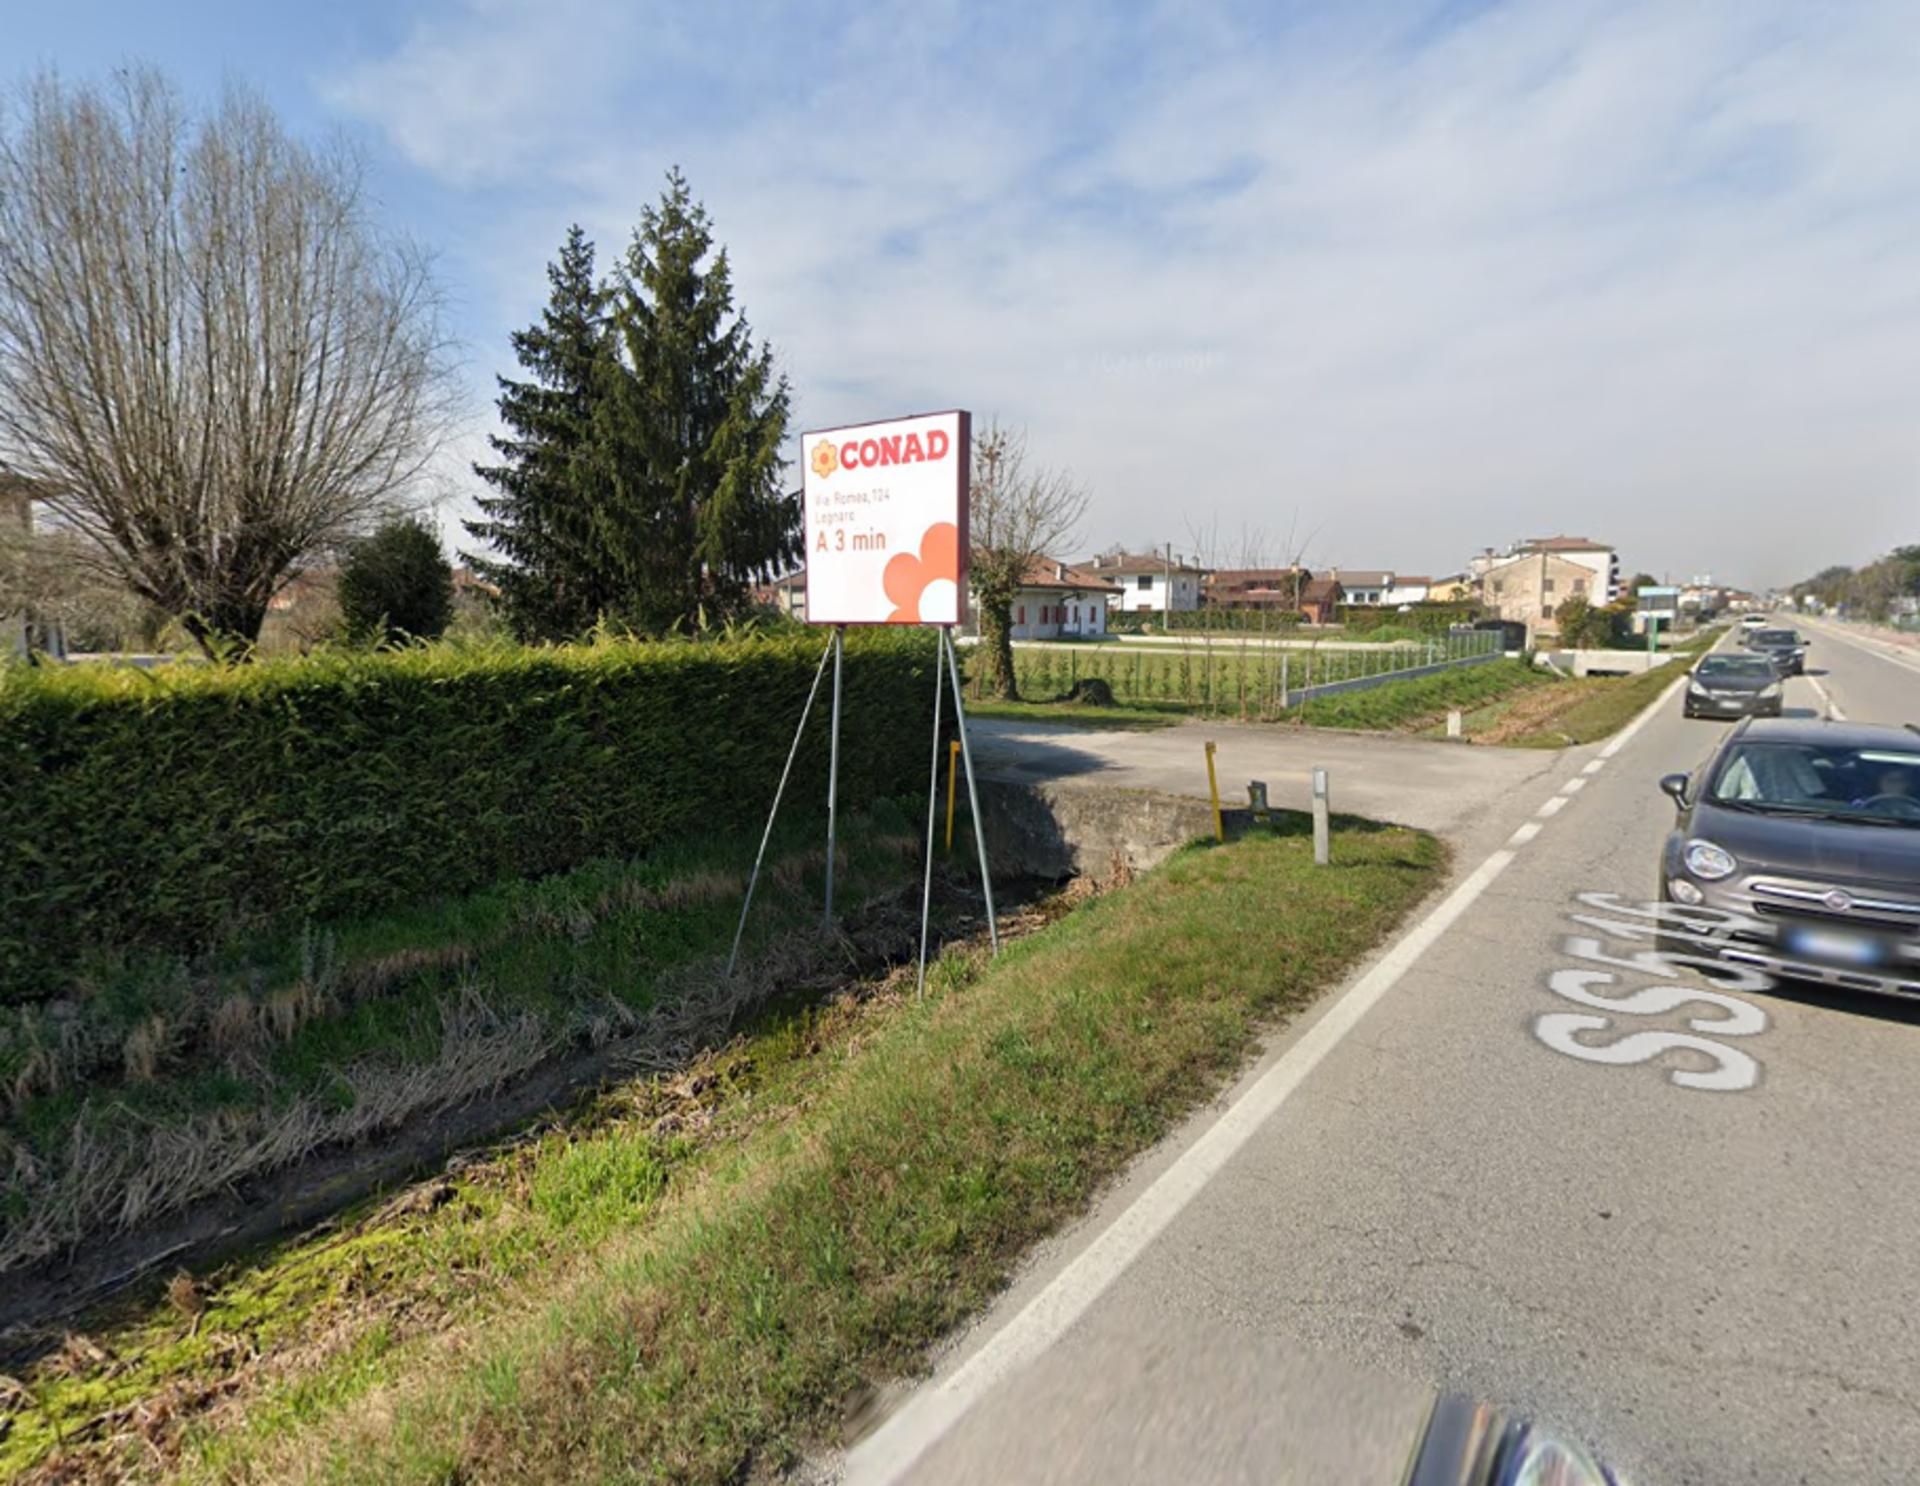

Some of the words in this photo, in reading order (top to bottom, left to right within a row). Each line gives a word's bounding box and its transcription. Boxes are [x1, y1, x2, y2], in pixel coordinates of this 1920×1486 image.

[841, 430, 949, 470] CONAD
[816, 530, 829, 553] A
[835, 528, 846, 552] 3
[853, 526, 887, 551] min
